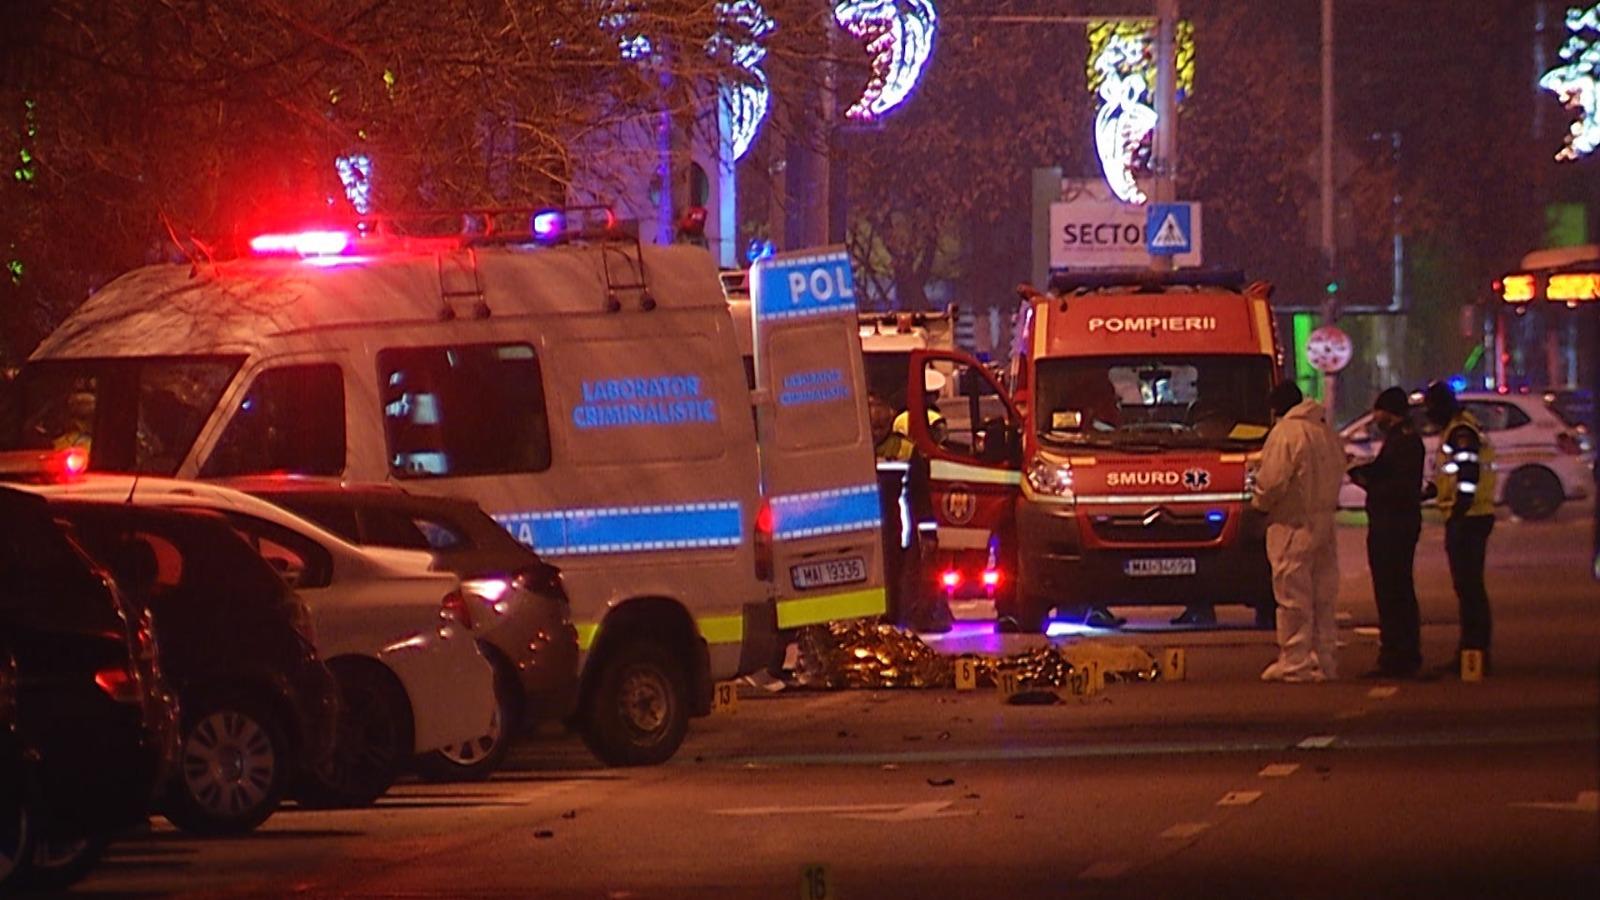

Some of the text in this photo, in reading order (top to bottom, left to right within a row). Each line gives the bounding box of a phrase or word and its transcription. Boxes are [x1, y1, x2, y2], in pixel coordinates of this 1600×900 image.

[788, 266, 853, 303] POL
[1088, 316, 1216, 332] POMPIERII
[582, 376, 699, 401] LABORATOR
[573, 400, 715, 427] CRIMINALISTIC
[1107, 471, 1180, 485] SMURD
[719, 684, 731, 705] 13
